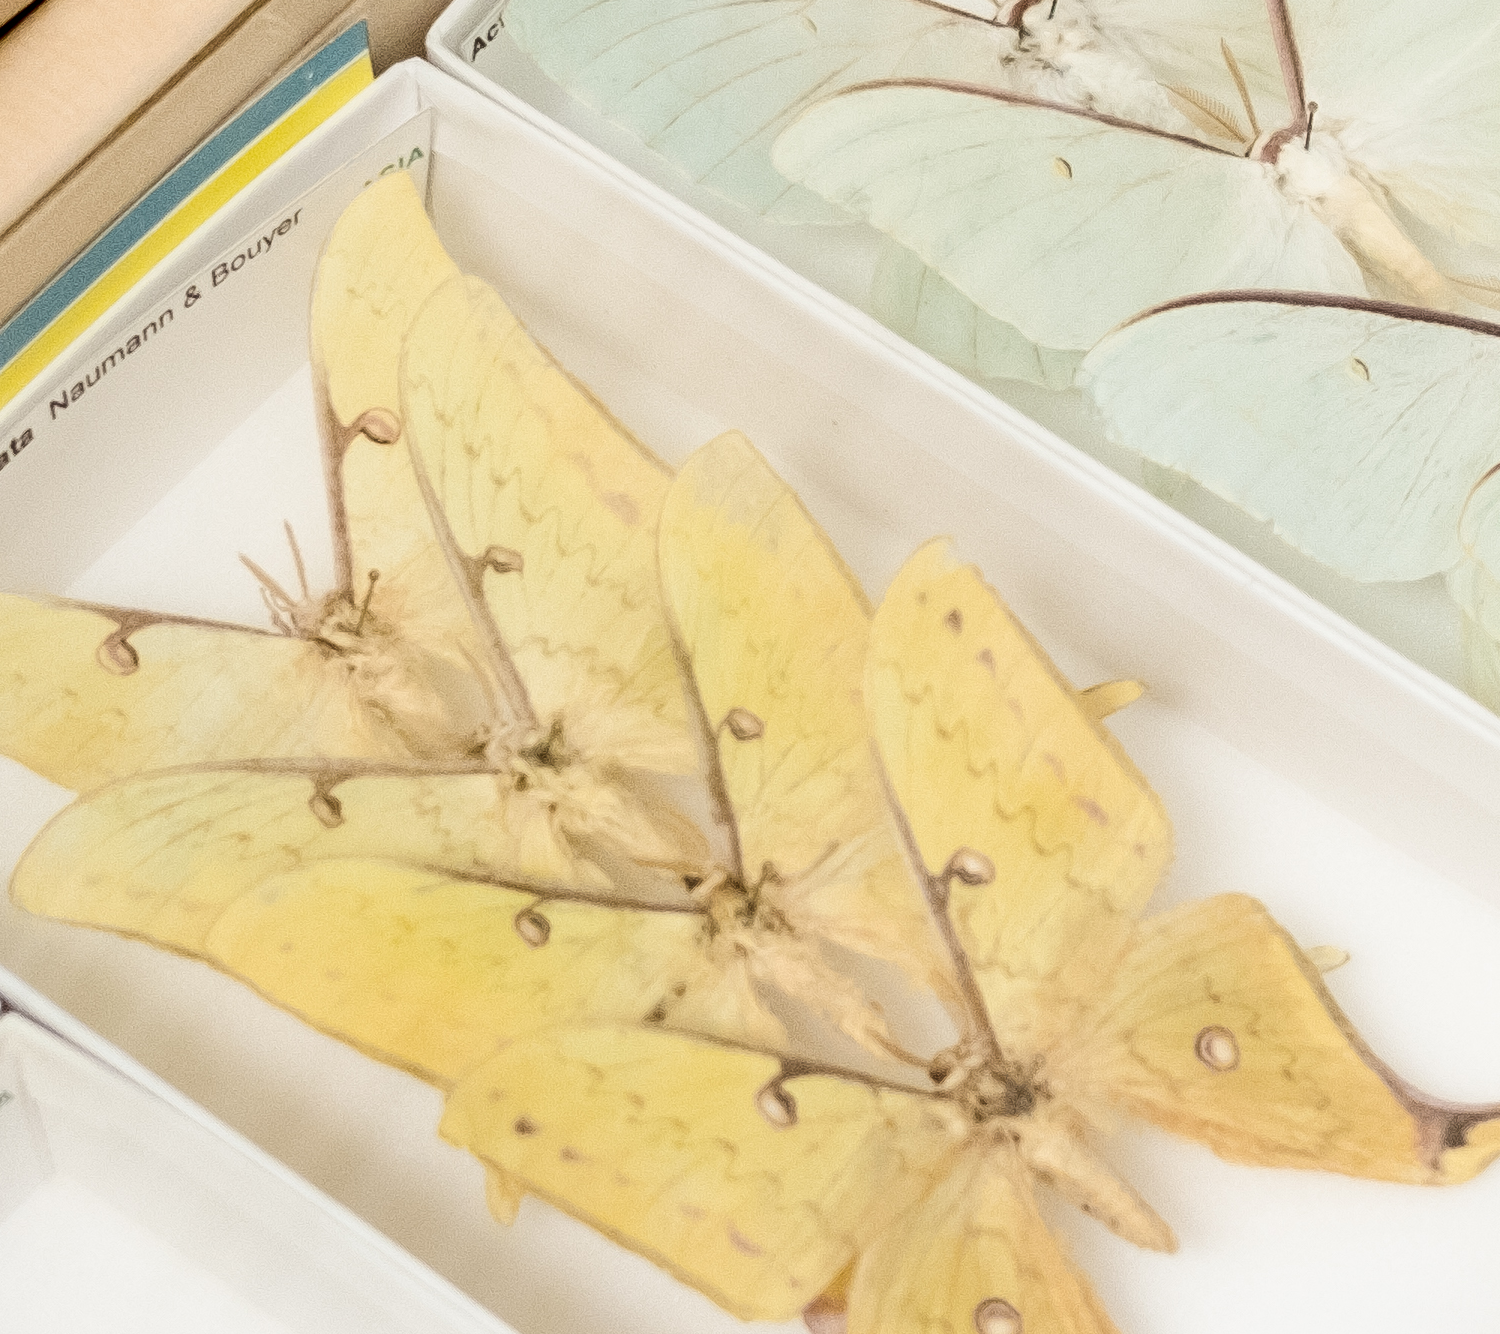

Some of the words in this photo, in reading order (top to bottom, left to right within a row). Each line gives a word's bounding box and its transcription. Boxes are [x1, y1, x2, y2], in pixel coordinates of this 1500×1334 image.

[47, 309, 177, 419] Naumann
[182, 283, 205, 309] &
[209, 205, 303, 290] Bouyer
